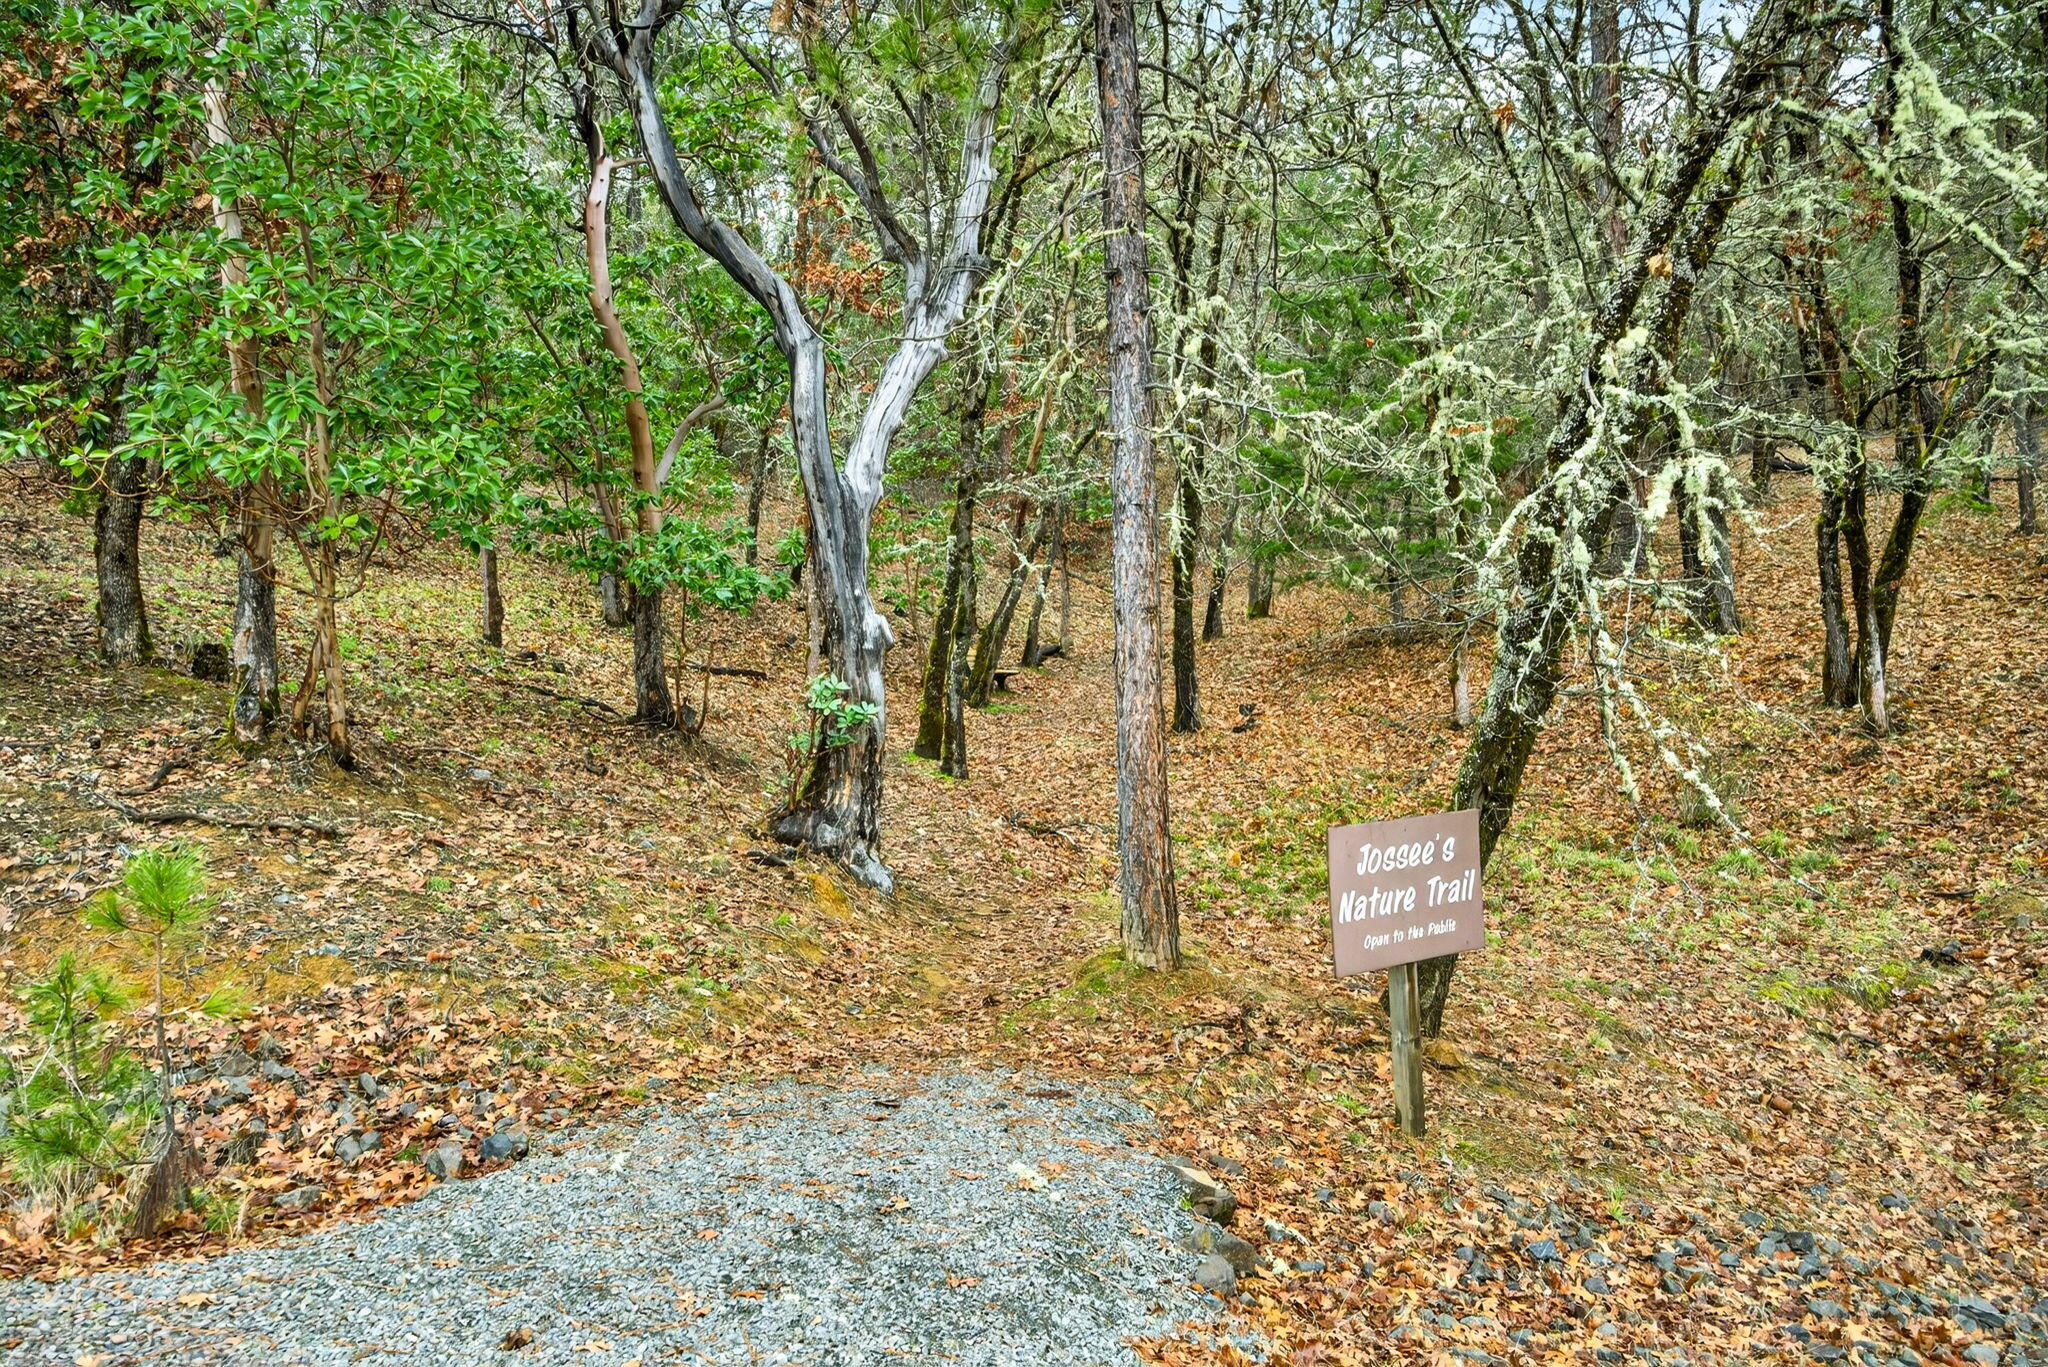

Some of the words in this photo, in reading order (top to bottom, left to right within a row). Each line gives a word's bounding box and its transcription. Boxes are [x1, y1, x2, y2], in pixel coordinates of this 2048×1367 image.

[1356, 832, 1456, 876] Jossee's
[1338, 885, 1417, 925] Nature
[1426, 868, 1476, 908] Trail
[1363, 933, 1390, 951] Open
[1392, 928, 1405, 944] to
[1407, 924, 1425, 940] the
[1427, 918, 1457, 937] Public
